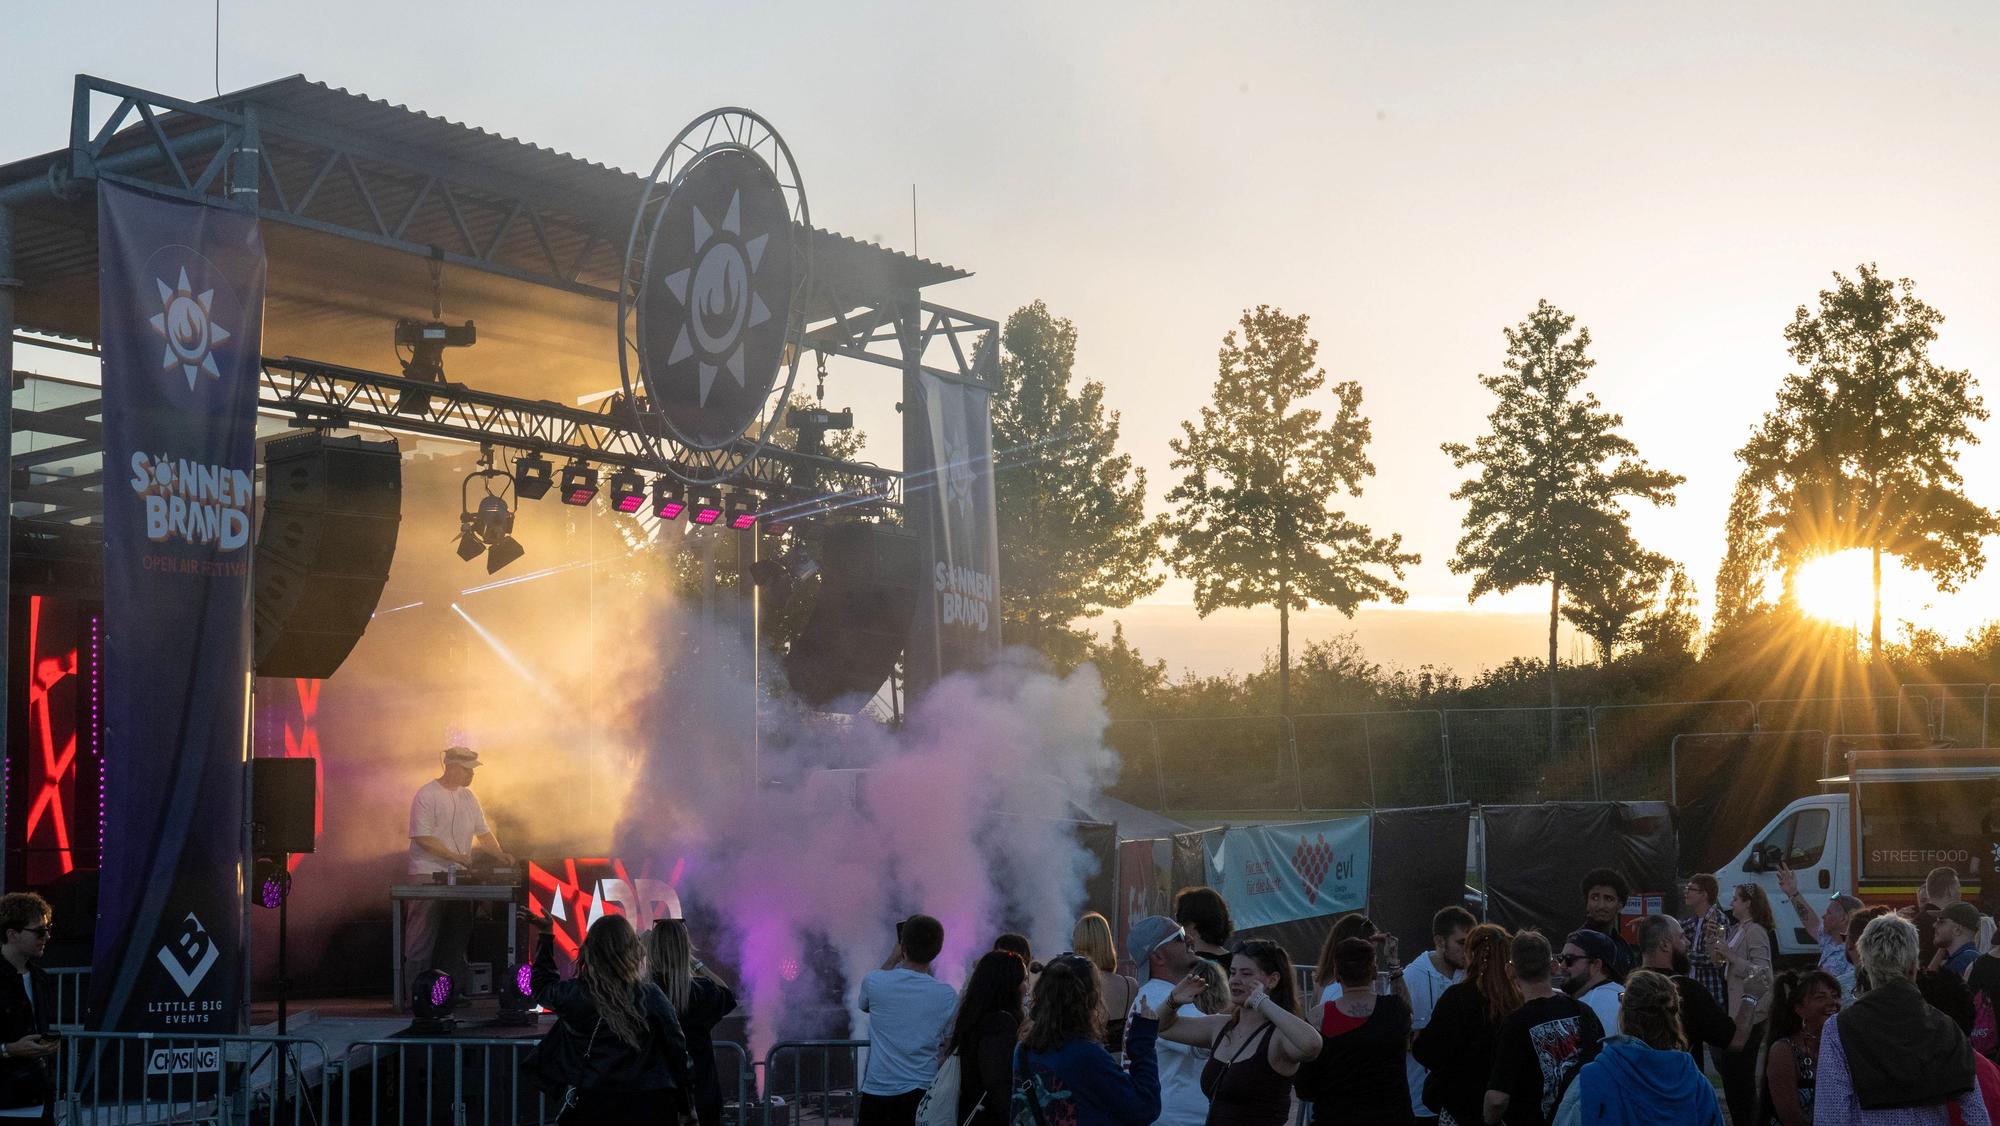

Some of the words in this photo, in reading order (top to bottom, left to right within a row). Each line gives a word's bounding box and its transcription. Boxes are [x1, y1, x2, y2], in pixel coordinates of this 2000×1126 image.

[146, 495, 250, 549] BRAND
[143, 555, 176, 572] OPEN
[178, 559, 199, 573] AIR
[943, 592, 989, 632] BRAND
[1871, 849, 1968, 862] STREETFOOD
[1335, 854, 1353, 881] evl
[149, 1002, 195, 1013] LITTLE
[202, 1001, 222, 1011] BIG
[166, 1014, 209, 1024] EVENTS
